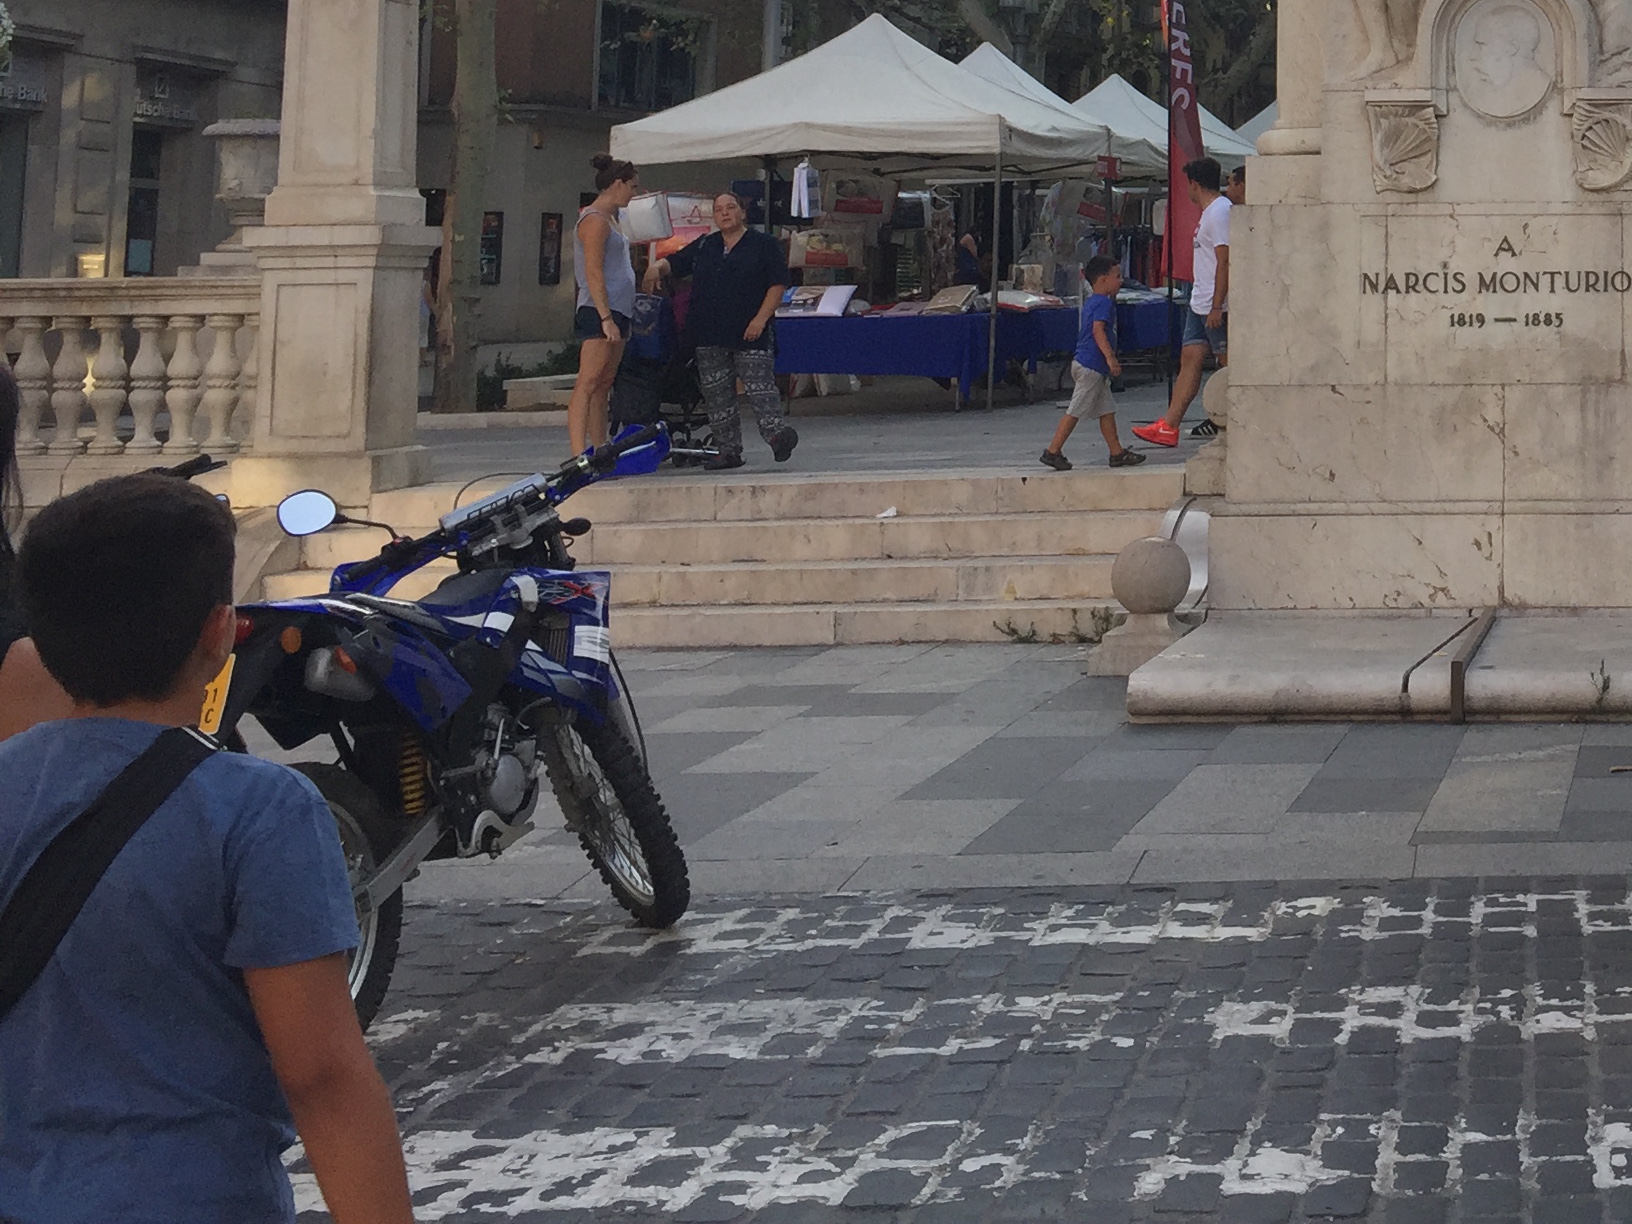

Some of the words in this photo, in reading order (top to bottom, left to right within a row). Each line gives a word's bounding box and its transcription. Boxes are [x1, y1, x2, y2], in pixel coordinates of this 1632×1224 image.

[17, 83, 47, 103] Bank
[1493, 235, 1518, 258] A
[1450, 312, 1486, 328] 1819
[1525, 312, 1564, 327] 1885
